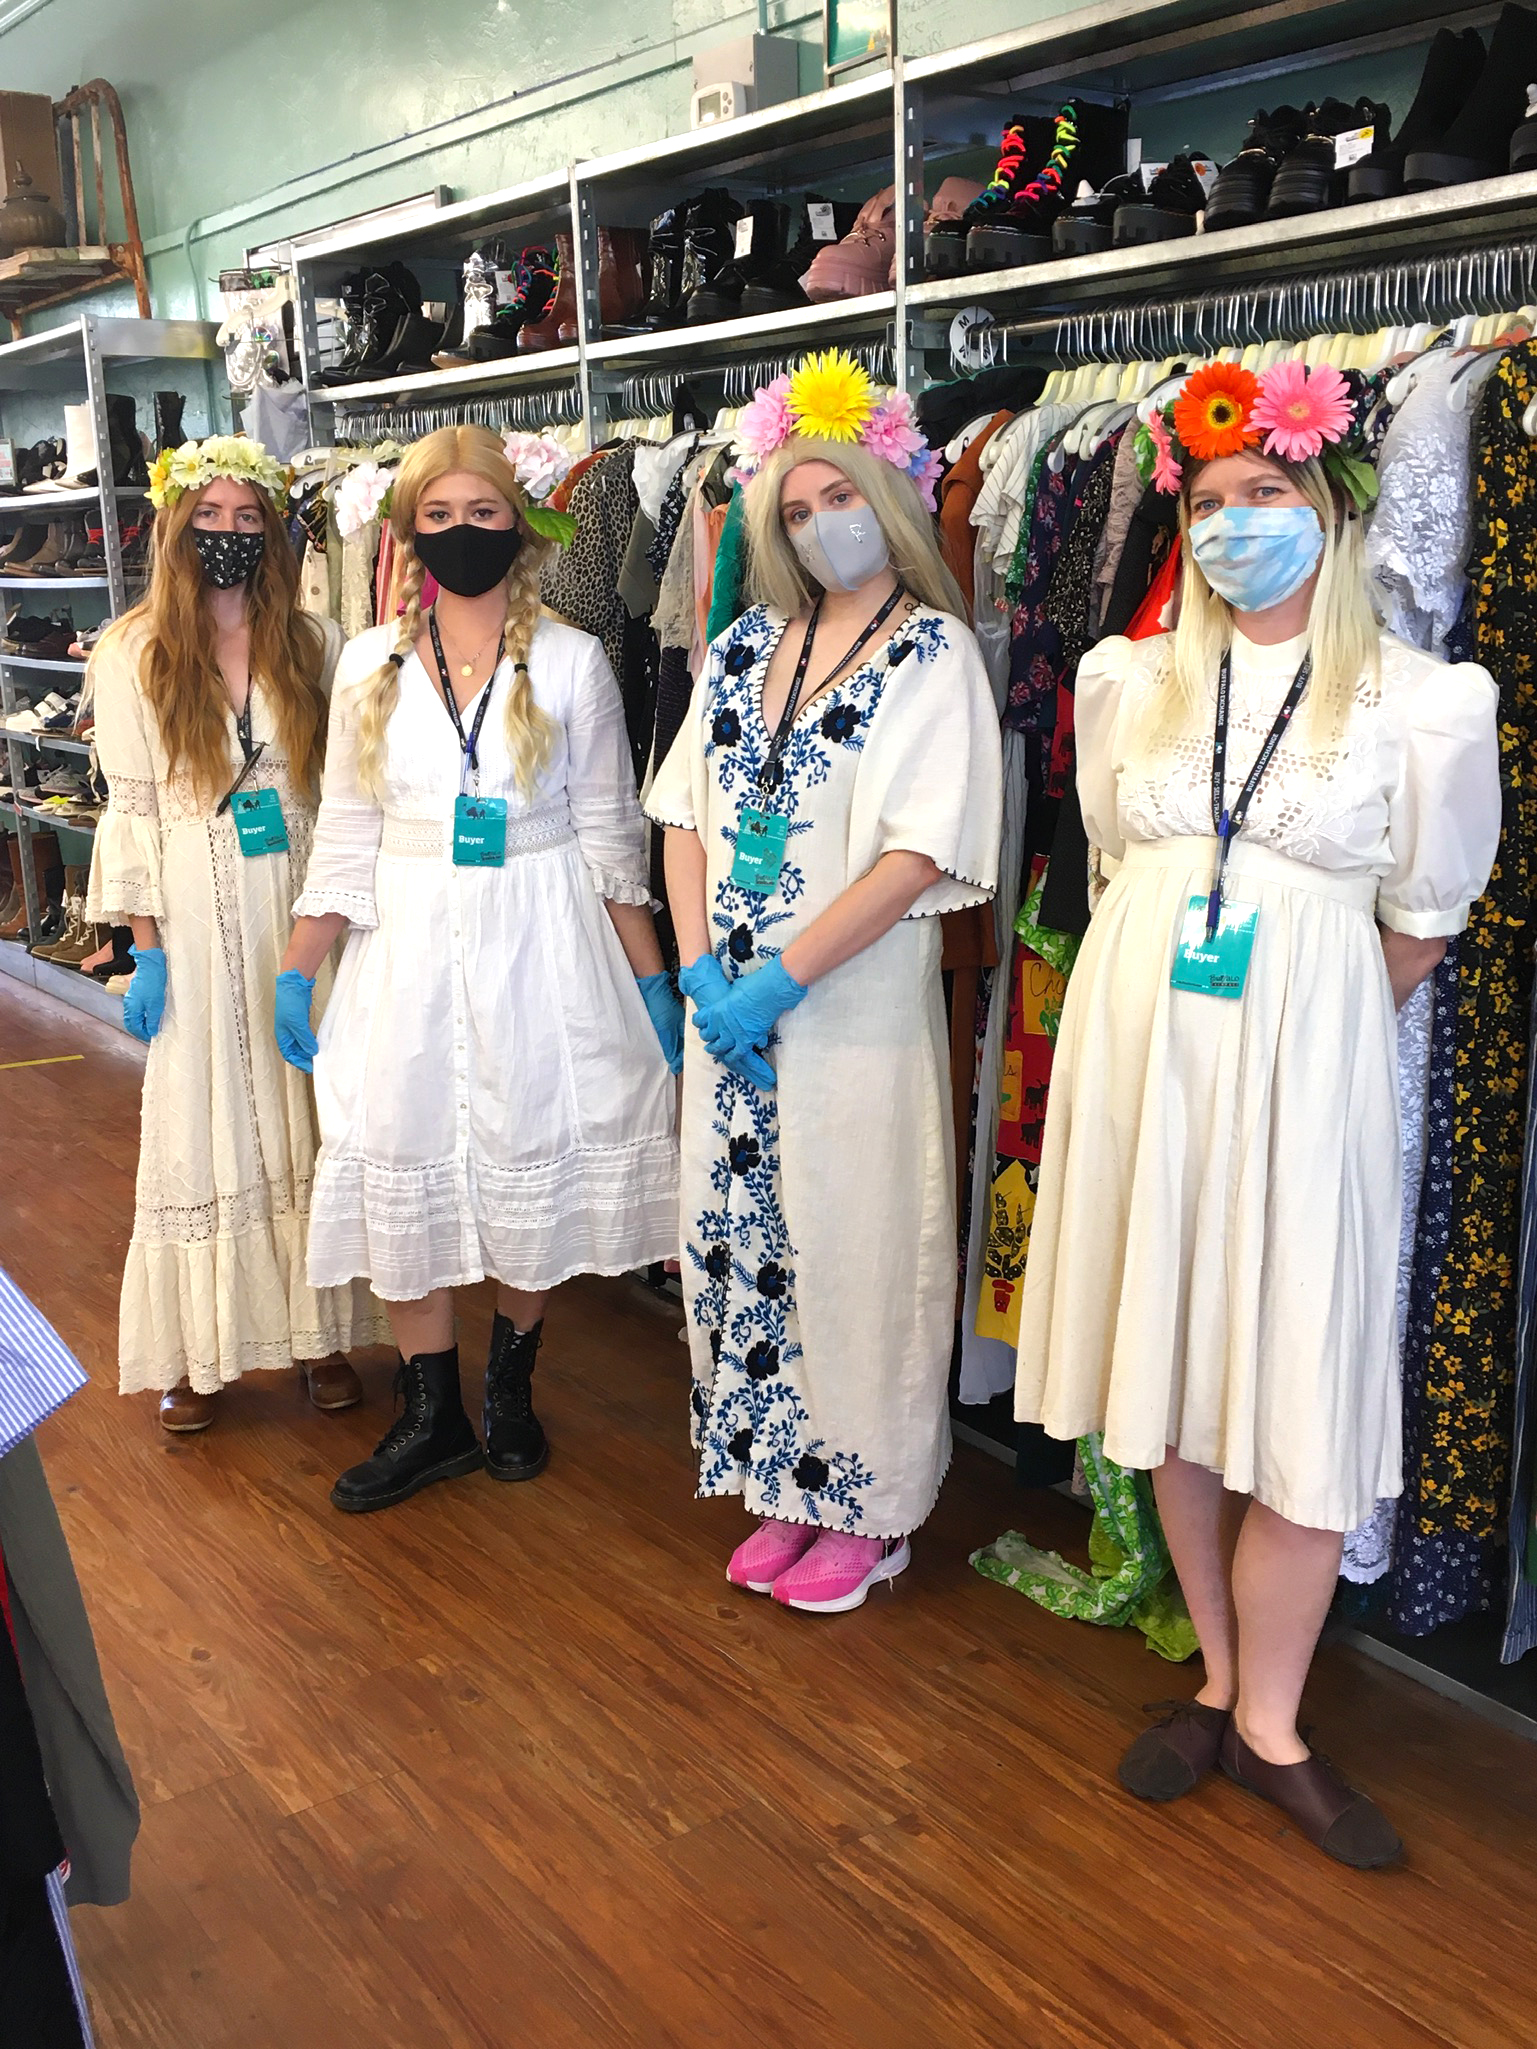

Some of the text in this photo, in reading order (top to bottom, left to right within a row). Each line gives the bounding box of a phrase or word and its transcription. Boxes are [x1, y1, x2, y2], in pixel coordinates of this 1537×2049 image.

[958, 315, 970, 329] M
[1246, 733, 1278, 792] BUFFALO EXCHANGE
[242, 825, 266, 835] Buyer
[458, 835, 485, 845] Buyer
[739, 852, 763, 864] Buyer
[1184, 949, 1220, 963] Buyer
